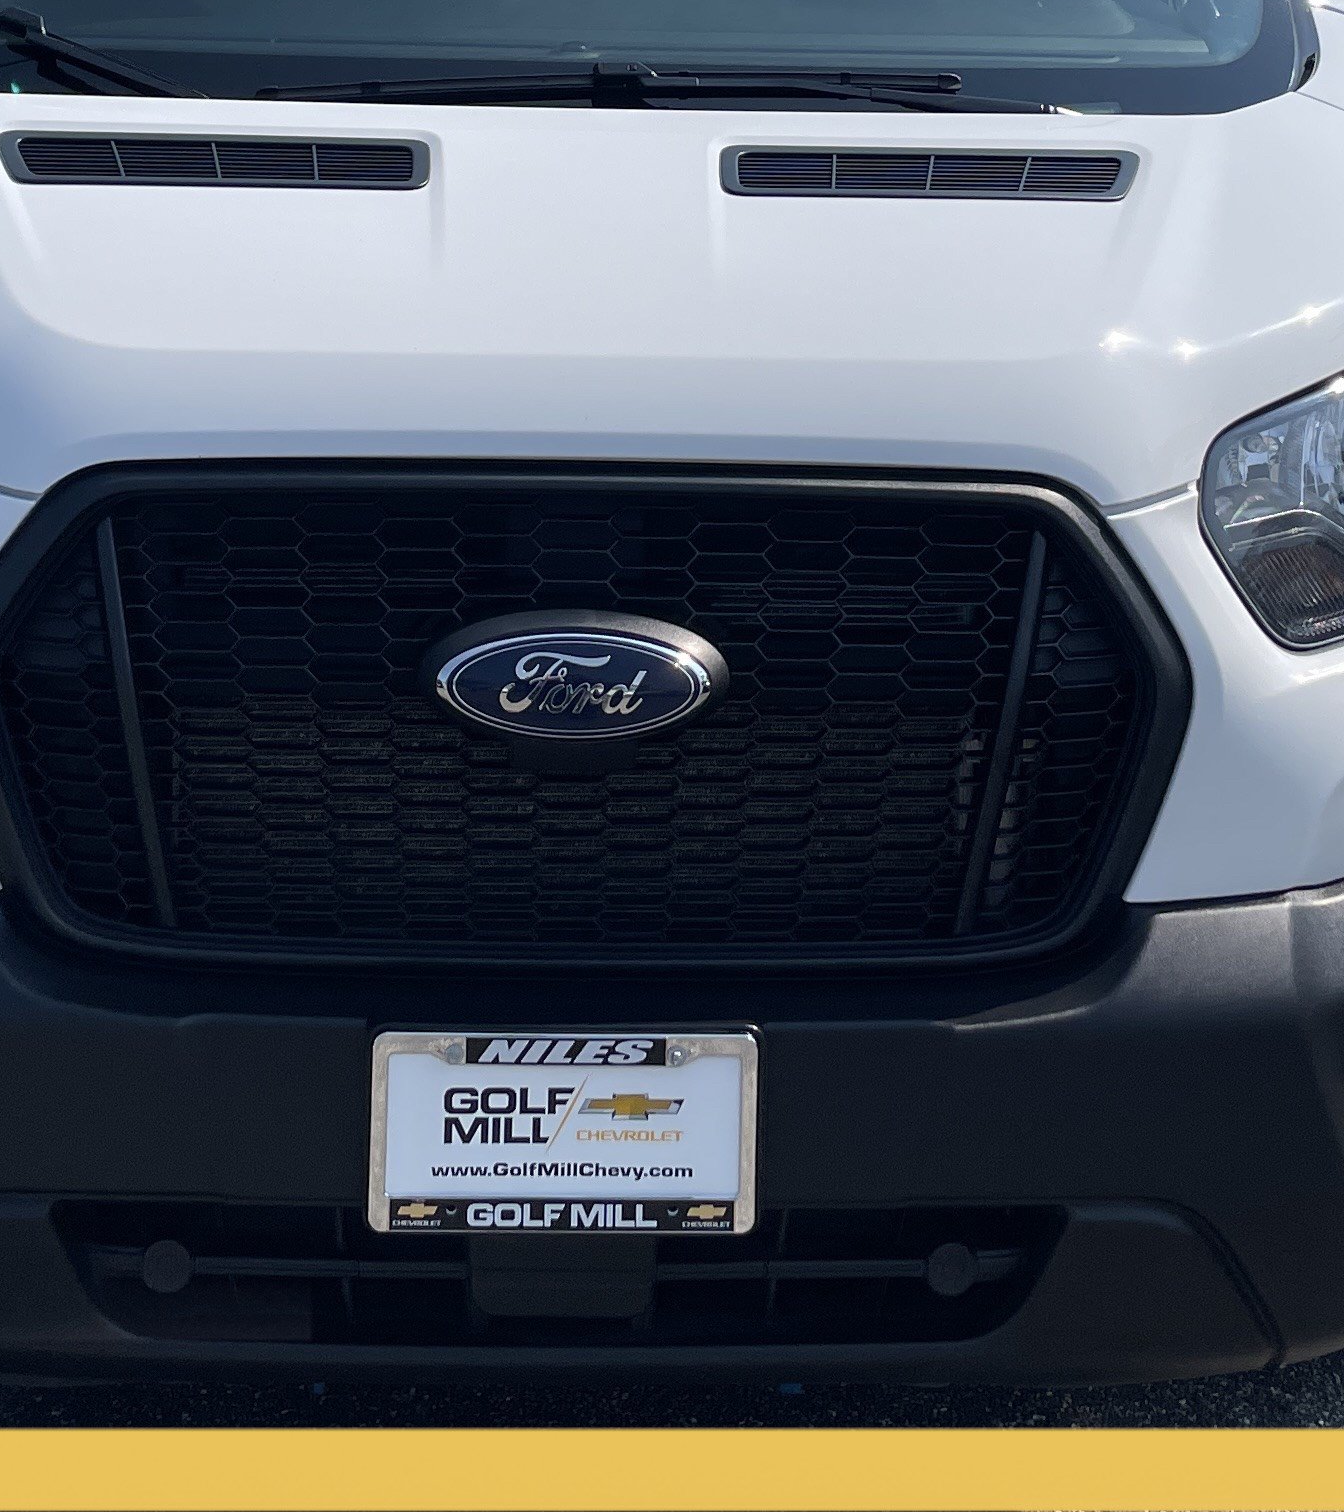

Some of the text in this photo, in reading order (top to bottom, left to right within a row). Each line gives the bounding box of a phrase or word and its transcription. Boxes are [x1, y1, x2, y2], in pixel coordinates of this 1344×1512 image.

[498, 650, 648, 716] Ford
[477, 1038, 655, 1065] NILES
[442, 1086, 575, 1115] GOLF
[442, 1116, 551, 1145] MILL
[575, 1128, 685, 1143] CHEVROLET
[430, 1161, 694, 1181] www.GolfMillChevy.com
[466, 1202, 658, 1229] GOLF MILL
